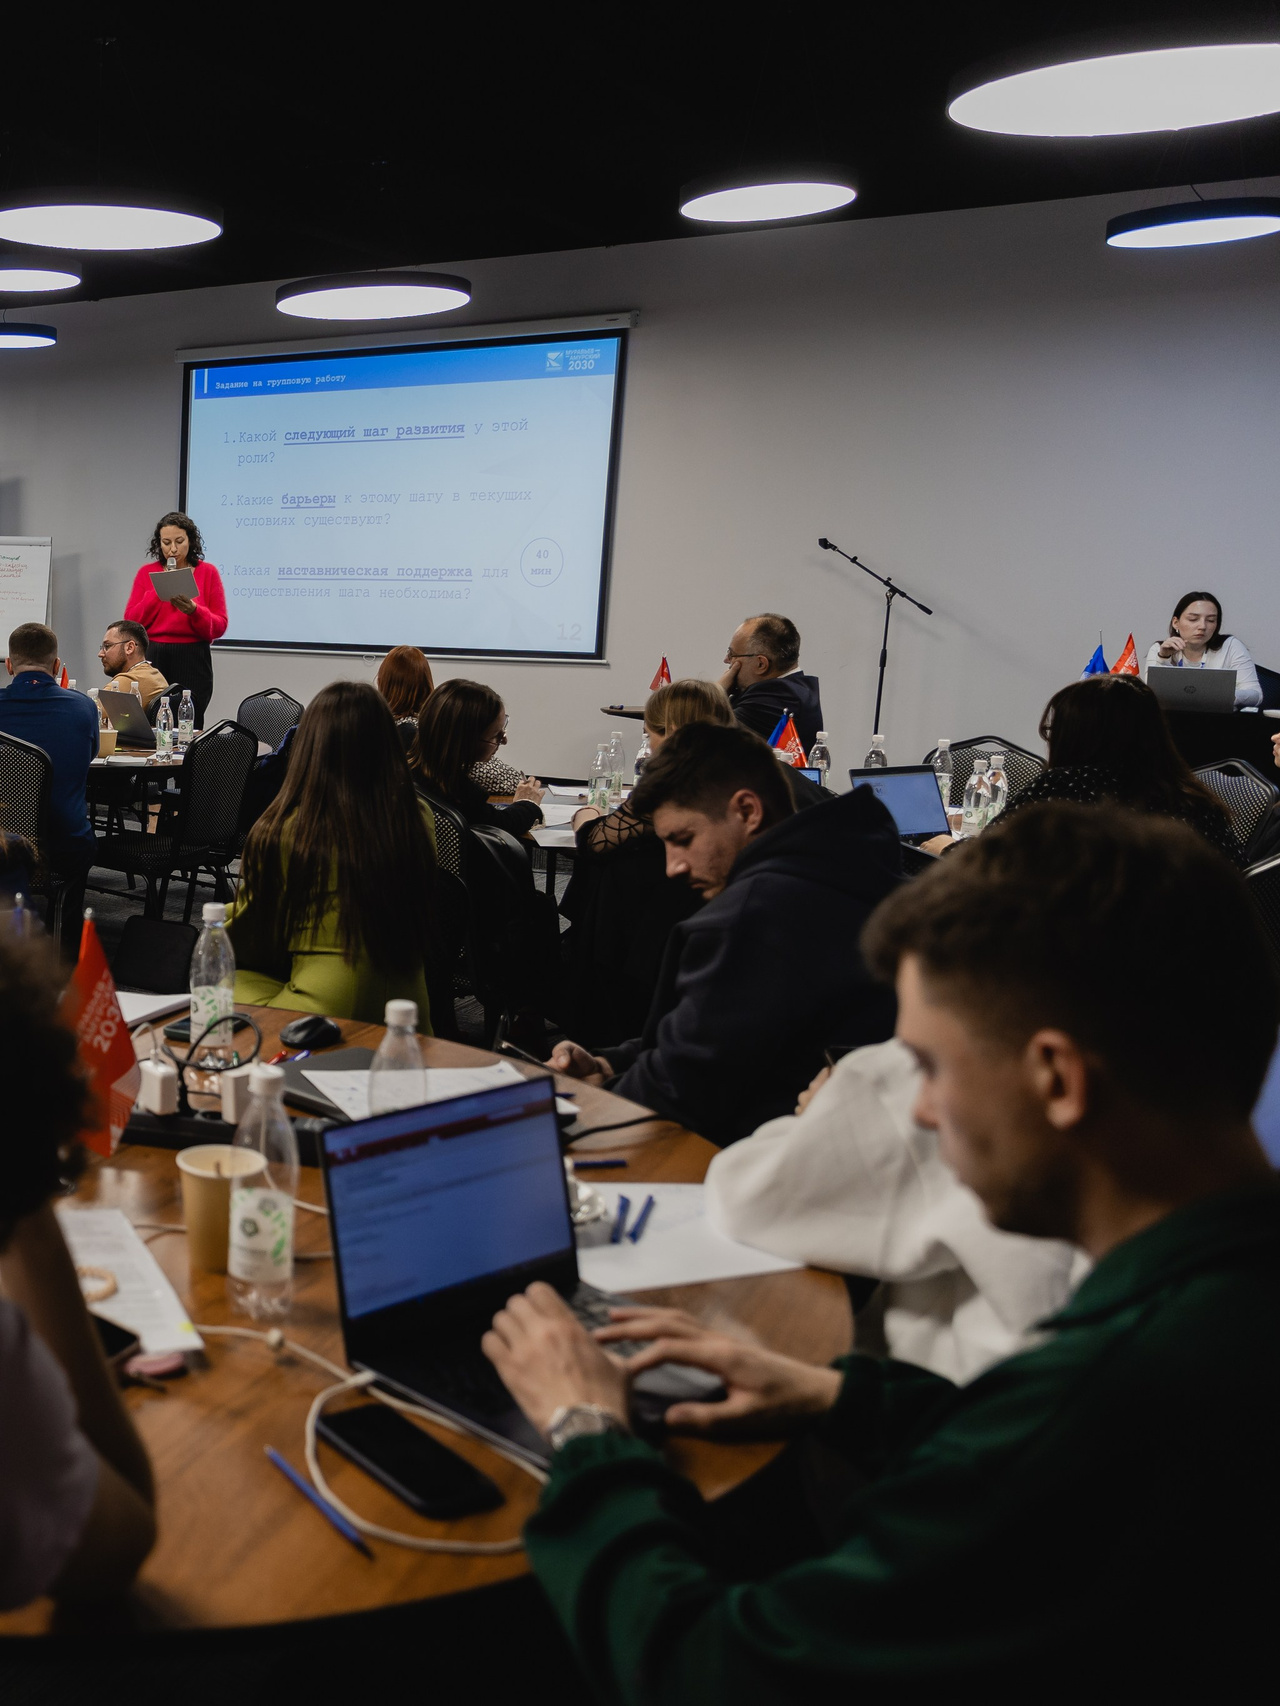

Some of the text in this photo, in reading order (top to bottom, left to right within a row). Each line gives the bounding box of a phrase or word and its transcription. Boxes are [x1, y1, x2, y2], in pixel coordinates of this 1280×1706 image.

[568, 359, 595, 371] 2030
[216, 381, 249, 390] Задание
[267, 378, 312, 388] групповую
[316, 374, 347, 385] работу
[285, 426, 356, 441] следующий
[364, 427, 389, 437] шаг
[396, 423, 465, 439] развития
[474, 422, 484, 435] у
[492, 418, 529, 432] этой
[238, 451, 275, 467] роли?
[282, 493, 336, 507] барьеры
[344, 494, 352, 504] к
[360, 492, 401, 505] этому
[410, 492, 444, 504] шагу
[453, 492, 461, 502] в
[470, 490, 532, 503] текущих
[236, 513, 391, 529] условиях существуют?
[536, 549, 549, 559] 40
[278, 566, 389, 576] наставническая
[397, 567, 473, 579] поддержка
[482, 568, 509, 578] для
[531, 567, 552, 576] мин
[233, 586, 471, 600] осуществления шага необходима?
[557, 622, 582, 641] 12
